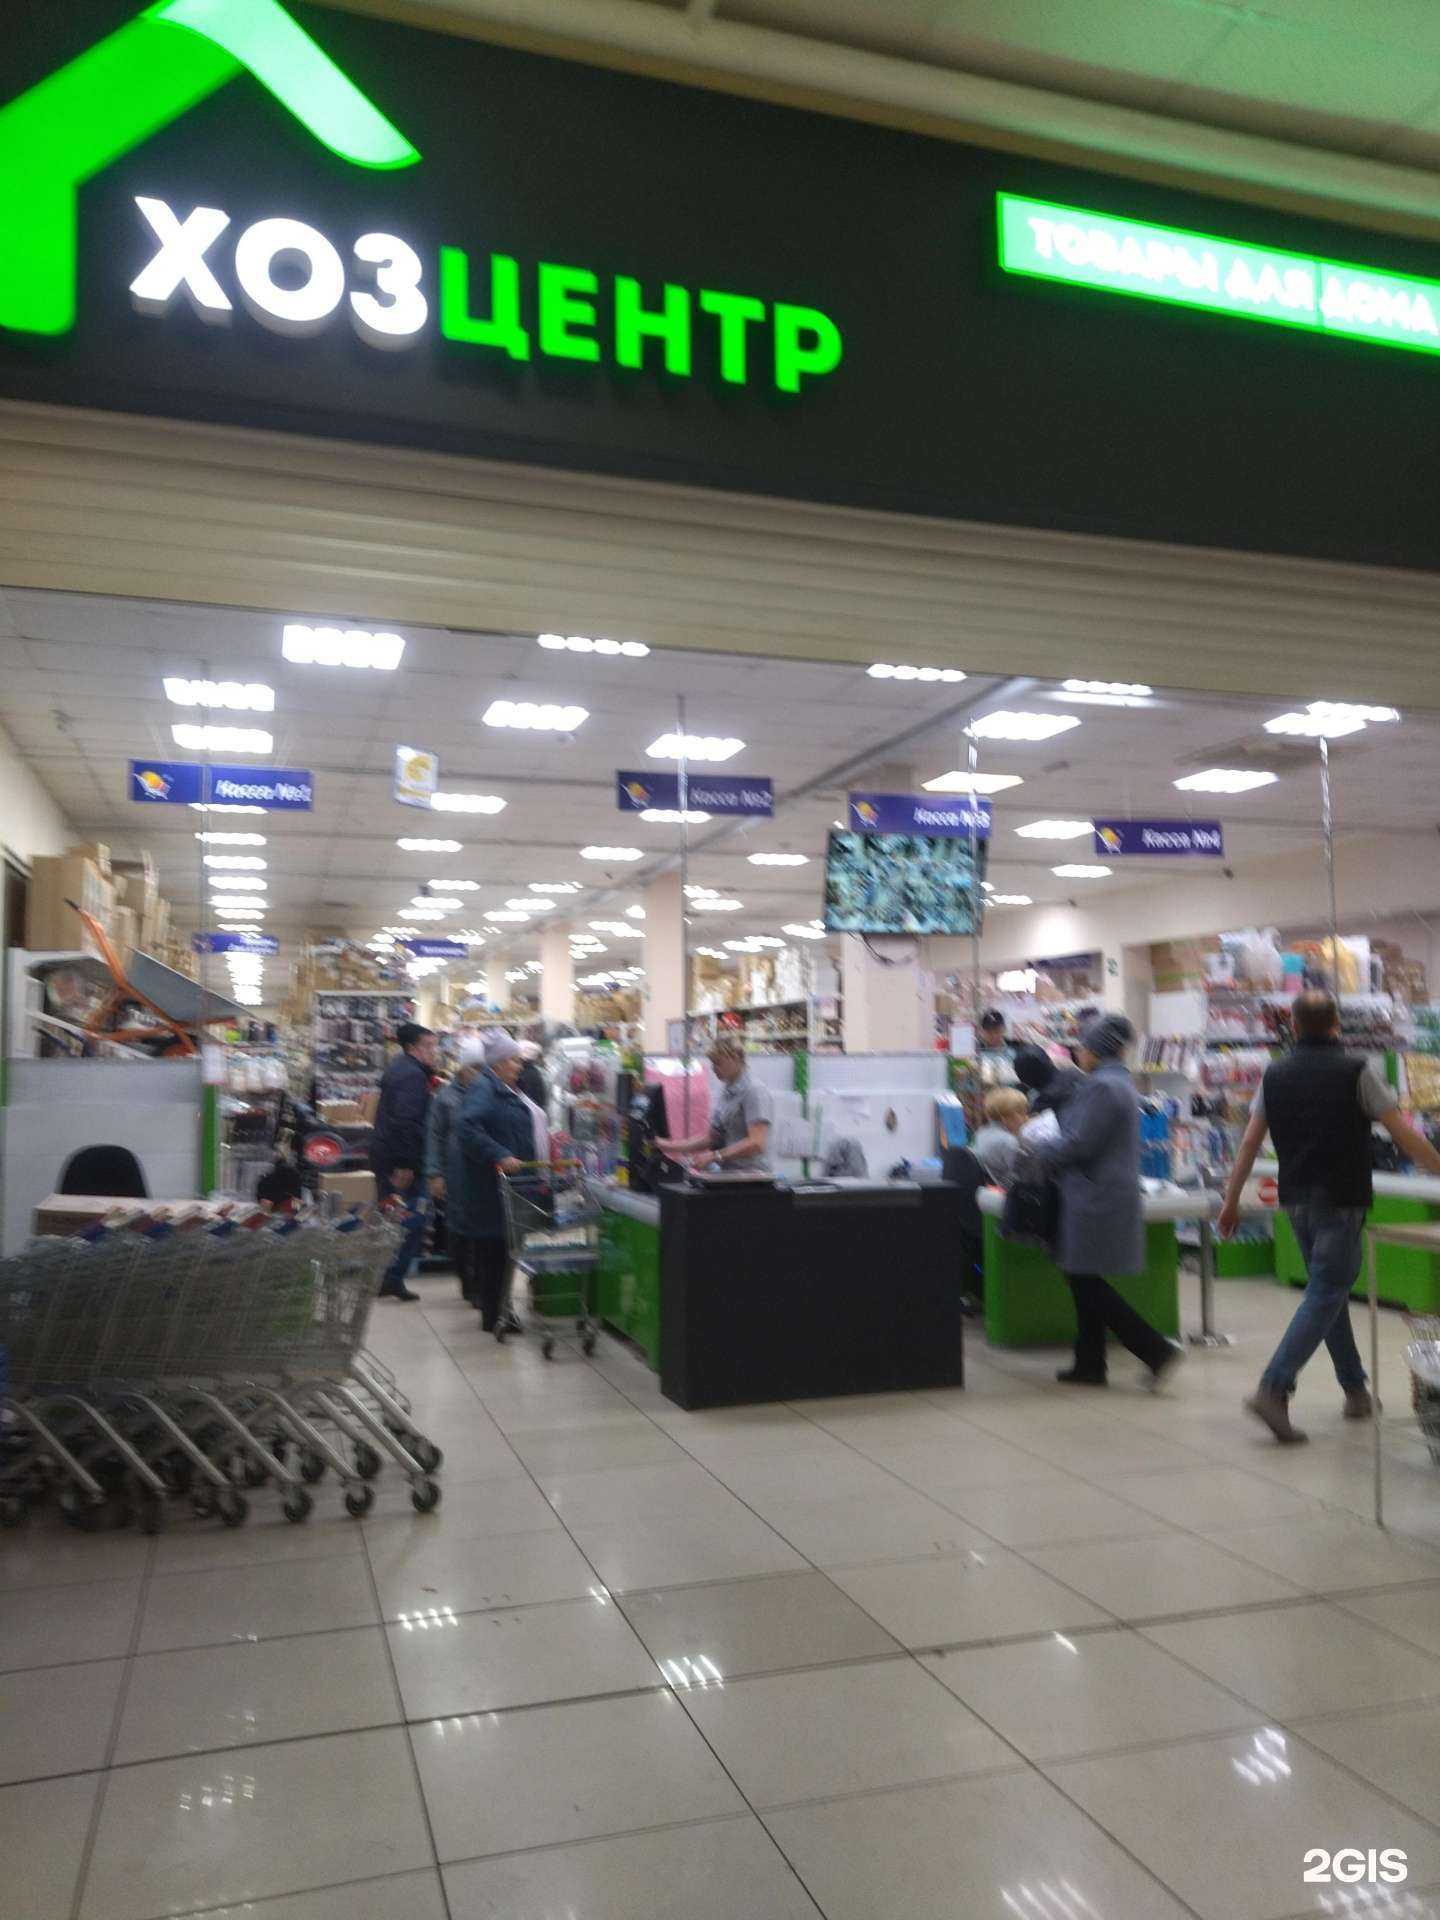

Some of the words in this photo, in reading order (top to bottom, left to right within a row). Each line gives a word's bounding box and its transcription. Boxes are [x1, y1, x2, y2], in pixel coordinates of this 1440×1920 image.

[1028, 216, 1220, 292] ТОВАРЫ
[1225, 256, 1316, 311] ДЛЯ
[1319, 276, 1439, 336] ДОМА
[130, 195, 843, 394] ХОЗЦЕНТР
[215, 780, 274, 800] Касса
[690, 787, 738, 806] Касса
[913, 807, 959, 826] Касса
[1142, 828, 1190, 848] Касса
